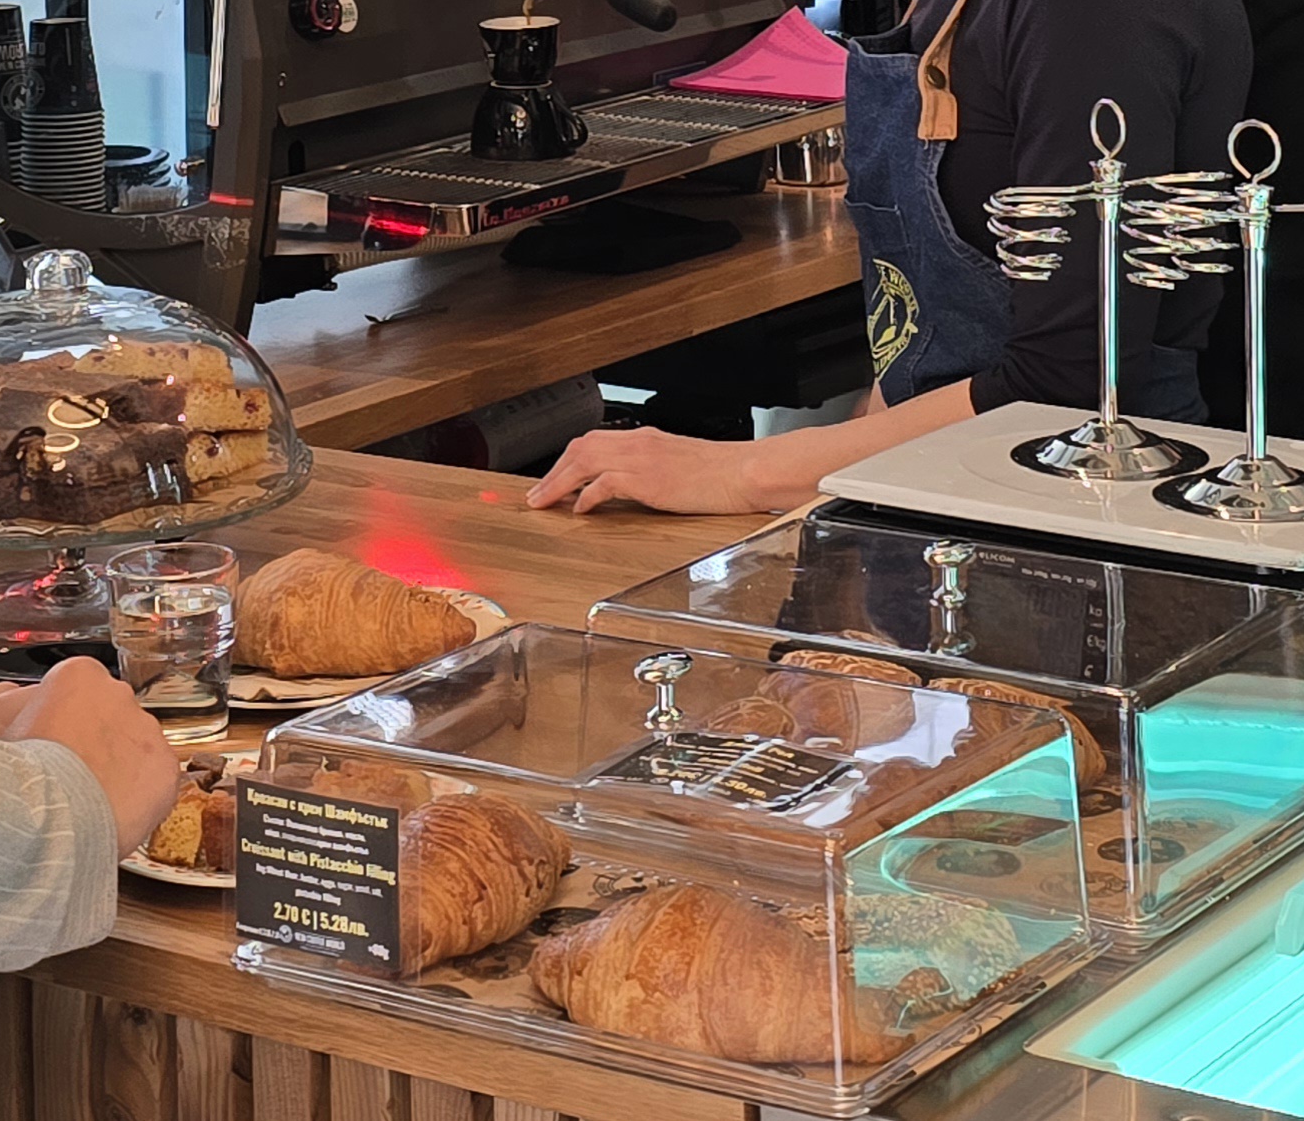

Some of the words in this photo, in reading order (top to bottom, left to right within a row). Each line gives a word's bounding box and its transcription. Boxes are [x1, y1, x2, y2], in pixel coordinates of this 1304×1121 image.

[240, 837, 286, 861] Croissant
[287, 848, 308, 866] with
[273, 901, 300, 923] 2.70
